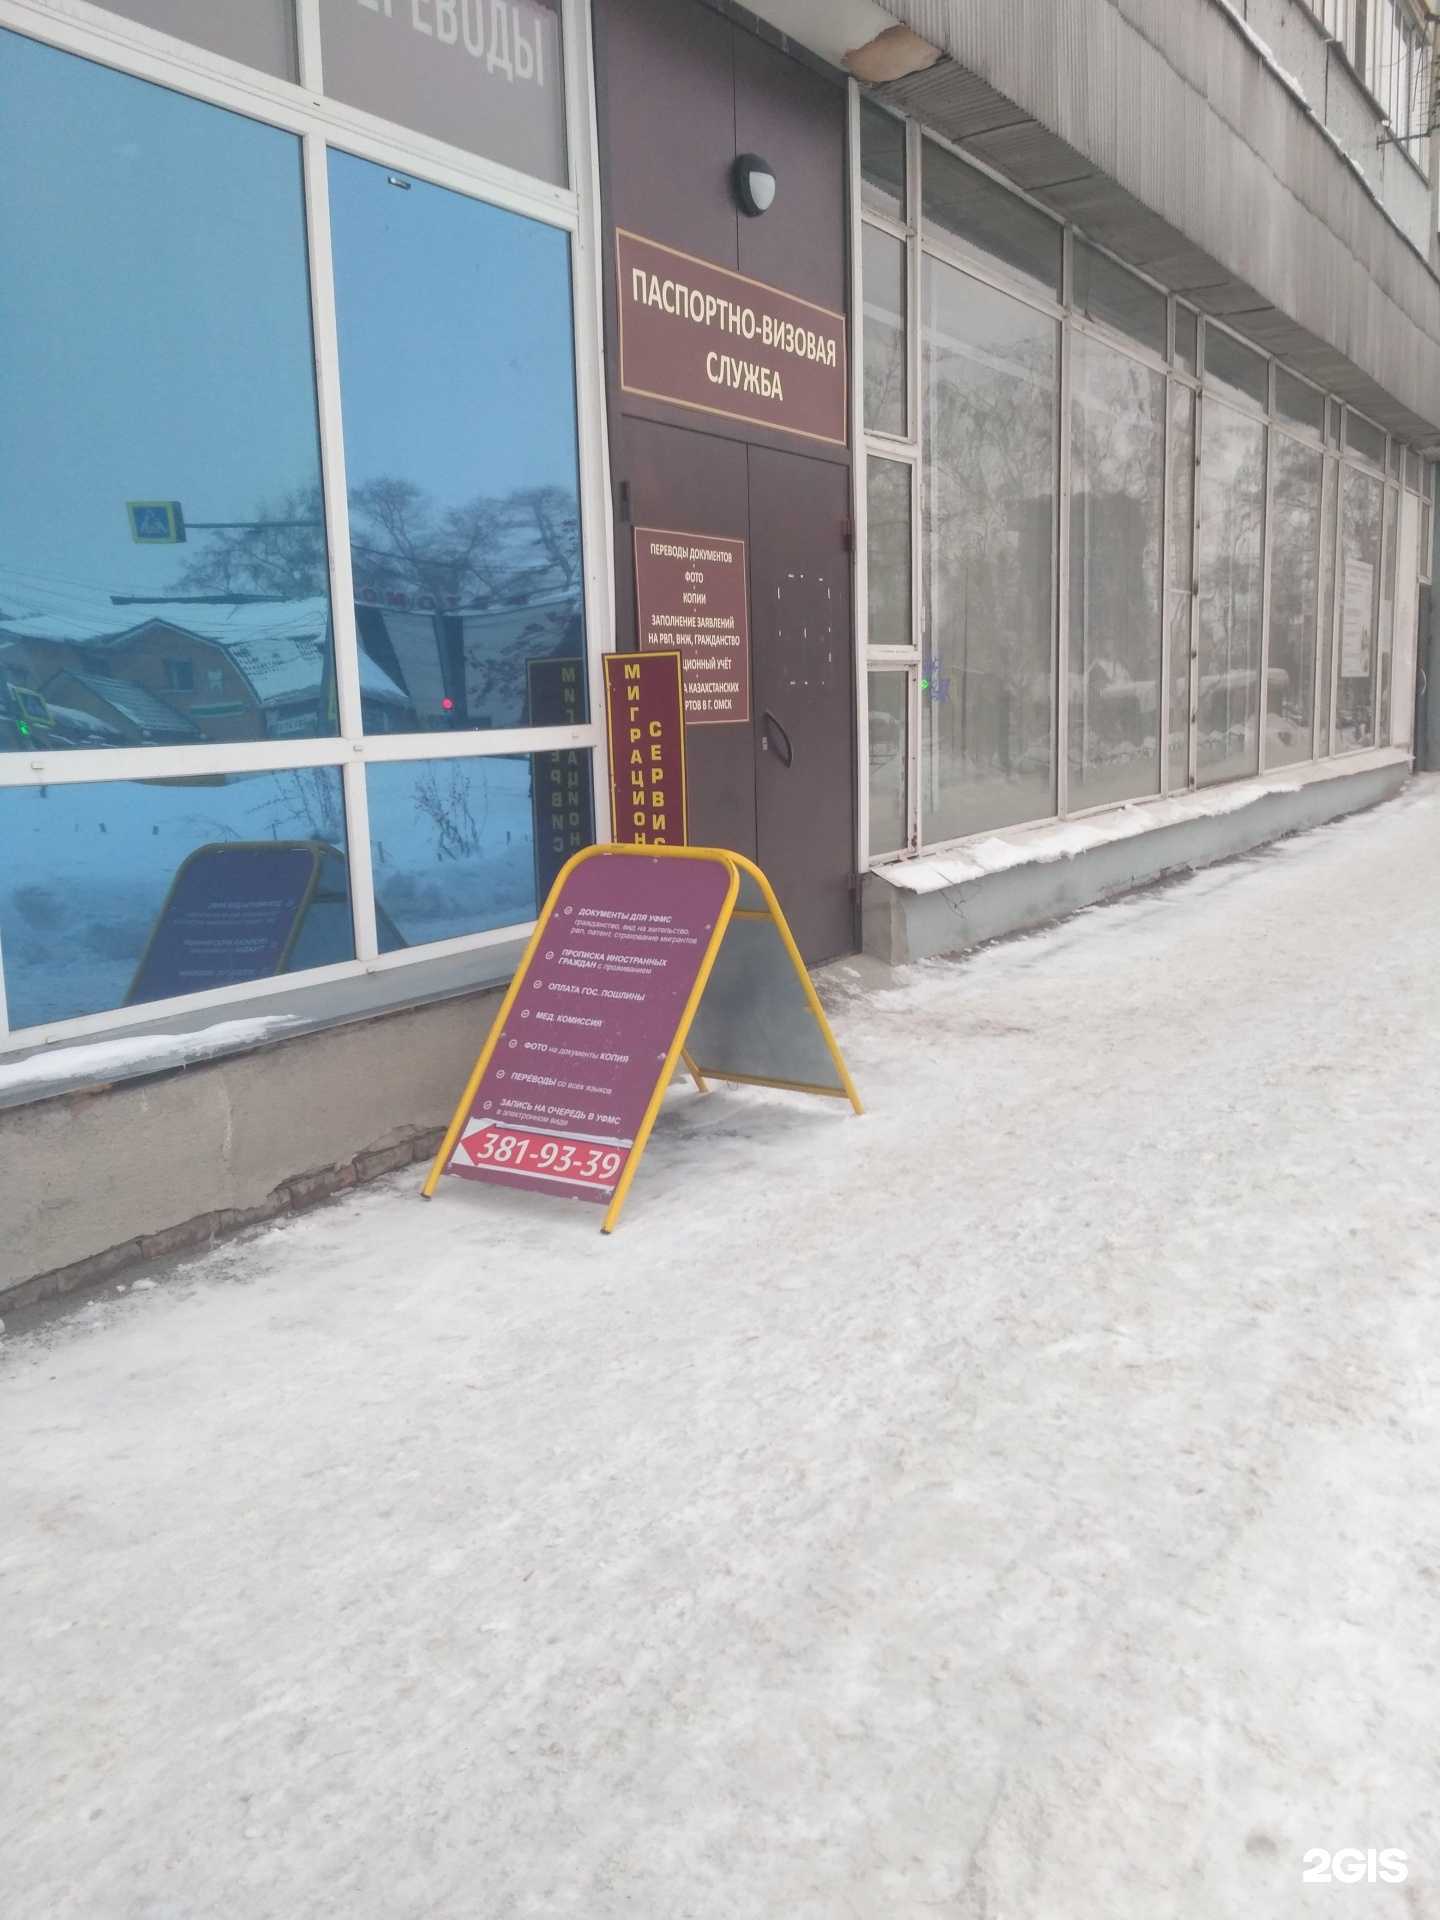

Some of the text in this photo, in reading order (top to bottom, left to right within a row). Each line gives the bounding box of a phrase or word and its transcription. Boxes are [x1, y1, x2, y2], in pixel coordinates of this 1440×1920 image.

[357, 0, 544, 87] ЕВОДЫ
[632, 268, 836, 367] ПАСПОРТНО-ВИЗОВАЯ
[706, 351, 784, 401] СЛУЖБА
[650, 543, 733, 563] ПЕРЕВОДЫ ДОКУМЕНТОВ
[685, 571, 704, 583] ФОТО
[683, 592, 706, 604] КОПИИ
[651, 614, 735, 629] ЗАПОЛНЕНИЕ ЗАЯВЛЕНИЙ
[648, 633, 658, 644] НА
[694, 634, 740, 647] ГРАЖДАНСТВО
[683, 657, 732, 671] ЦИОННЫЙ УЧЁТ
[689, 682, 740, 693] КАЗАХСТАНСКИХ
[685, 699, 702, 711] РТОВ
[713, 698, 732, 710] ОМСК
[624, 663, 646, 845] МИГРАЦИОН
[578, 907, 673, 923] ДОКУМЕНТЫ ДЛЯ УФМС
[558, 957, 597, 969] ГРАЖДАН
[561, 949, 668, 967] ПРОПИСКА ИНОСТРАННЫХ
[547, 982, 580, 993] ОПЛАТА
[601, 989, 645, 1001] ПОШЛИНЫ
[557, 1015, 603, 1027] КОМИССИЯ
[524, 1042, 548, 1052] ФОТО
[600, 1052, 629, 1063] КОПИЯ
[511, 1072, 557, 1087] ПЕРЕВОДЫ
[500, 1098, 533, 1111] ЗАПИСЬ
[534, 1103, 546, 1112] НА
[547, 1106, 586, 1120] ОЧЕРЕДЬ
[596, 1113, 622, 1125] УФМС
[477, 1133, 621, 1179] 381-93-39
